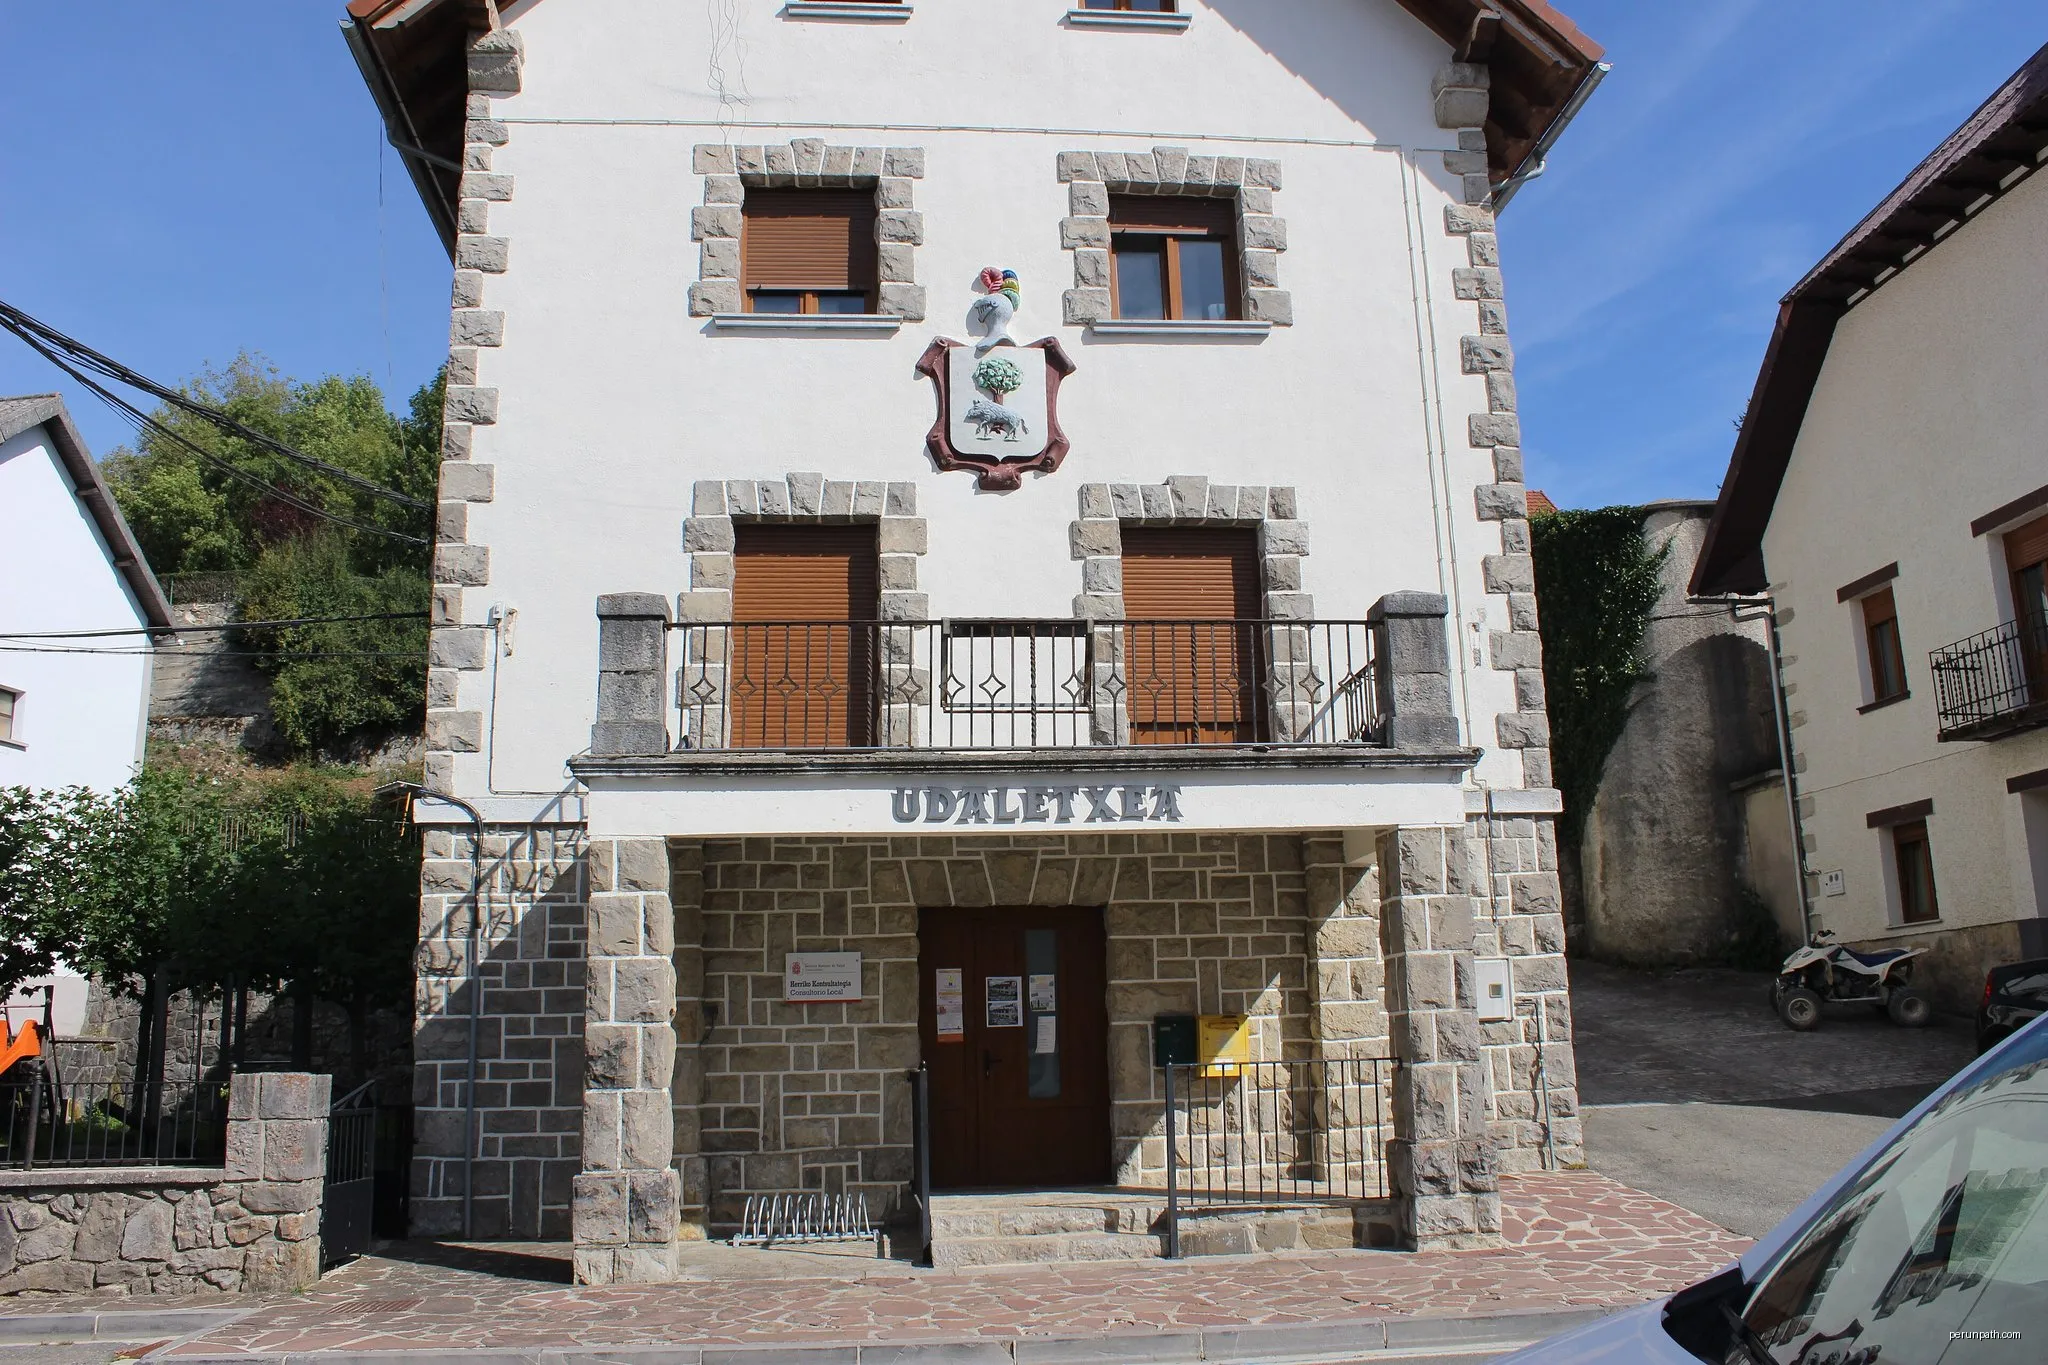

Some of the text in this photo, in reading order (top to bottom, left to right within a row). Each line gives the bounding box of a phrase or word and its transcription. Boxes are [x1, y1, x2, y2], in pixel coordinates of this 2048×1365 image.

[891, 785, 1184, 824] UDALETXEA
[790, 980, 811, 988] Herriko
[827, 988, 844, 996] Local
